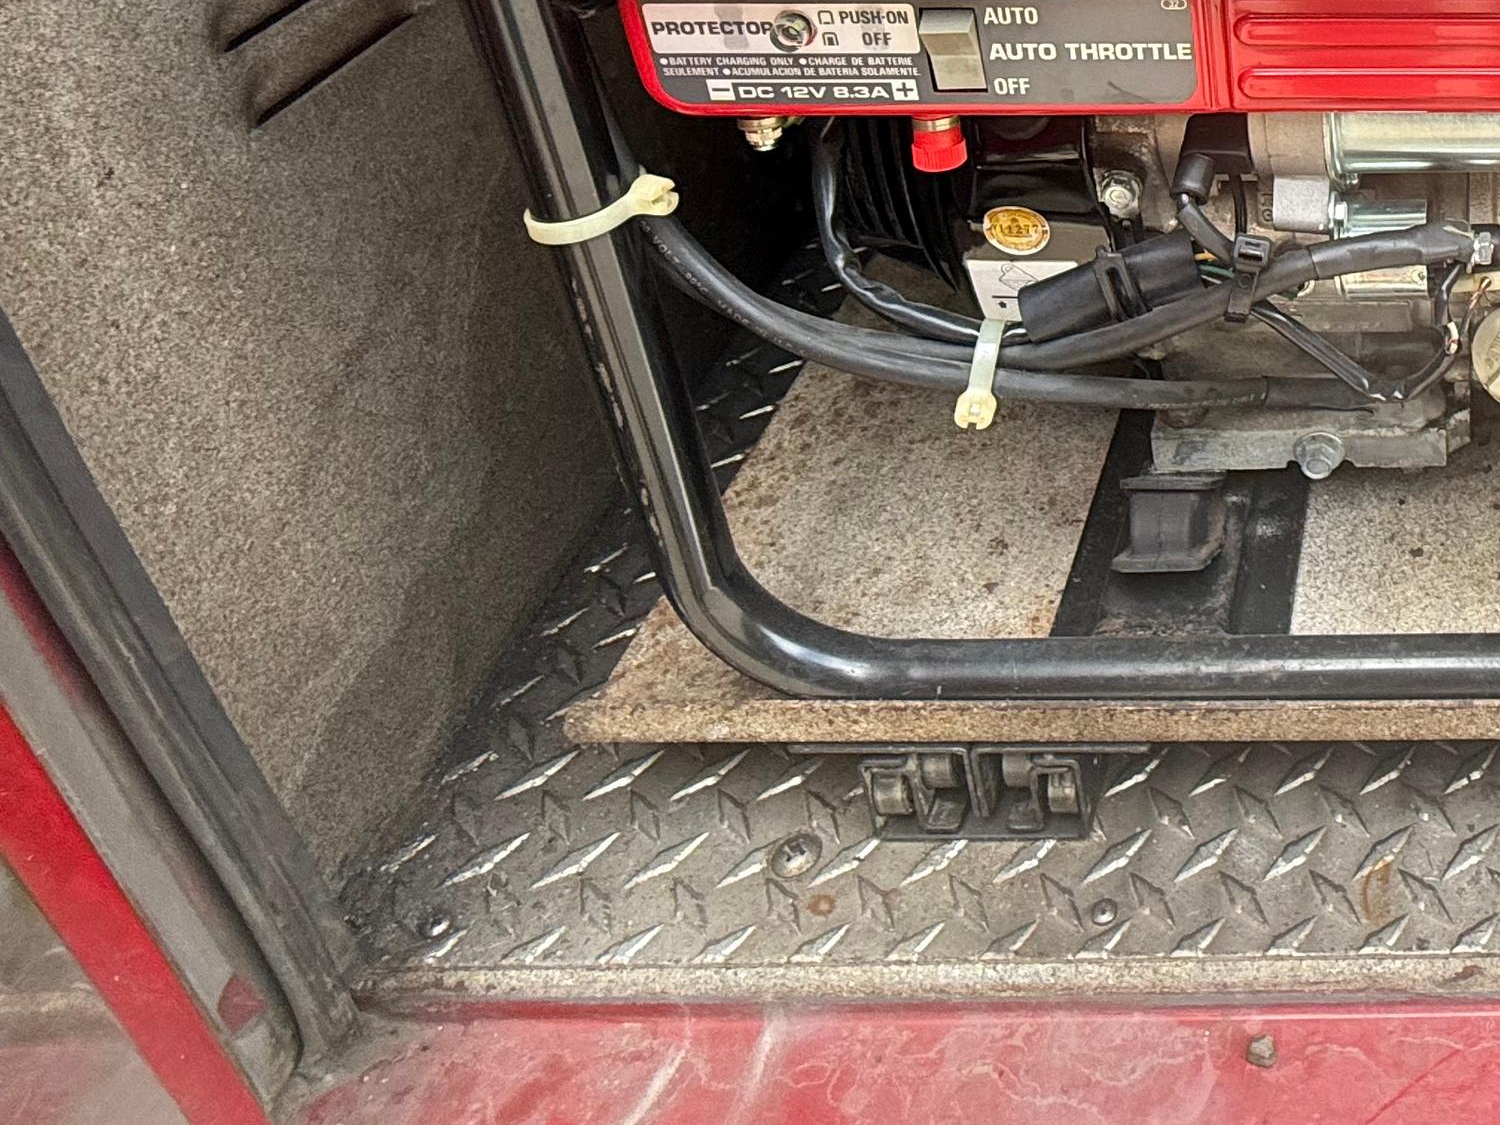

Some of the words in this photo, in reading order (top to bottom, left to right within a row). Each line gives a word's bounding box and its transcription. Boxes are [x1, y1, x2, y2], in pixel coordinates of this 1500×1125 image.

[838, 10, 909, 25] PUSH-ON
[983, 6, 1039, 25] AUTO
[653, 21, 773, 36] PROTECTOR
[861, 31, 893, 46] OFF
[989, 42, 1057, 61] AUTO
[1065, 43, 1193, 61] THROTTLE
[669, 57, 712, 66] BATTERY
[716, 57, 767, 66] CHARGING
[771, 57, 794, 66] ONLY
[808, 57, 848, 66] CHARGE
[851, 57, 865, 66] DE
[868, 57, 913, 66] BATTERIE
[664, 67, 719, 76] SEULEMENT
[731, 67, 801, 76] ACUMULACION
[804, 68, 816, 76] DE
[737, 86, 776, 99] DC
[780, 86, 827, 99] 12V
[832, 86, 889, 99] 8.3A
[993, 77, 1031, 95] OFF
